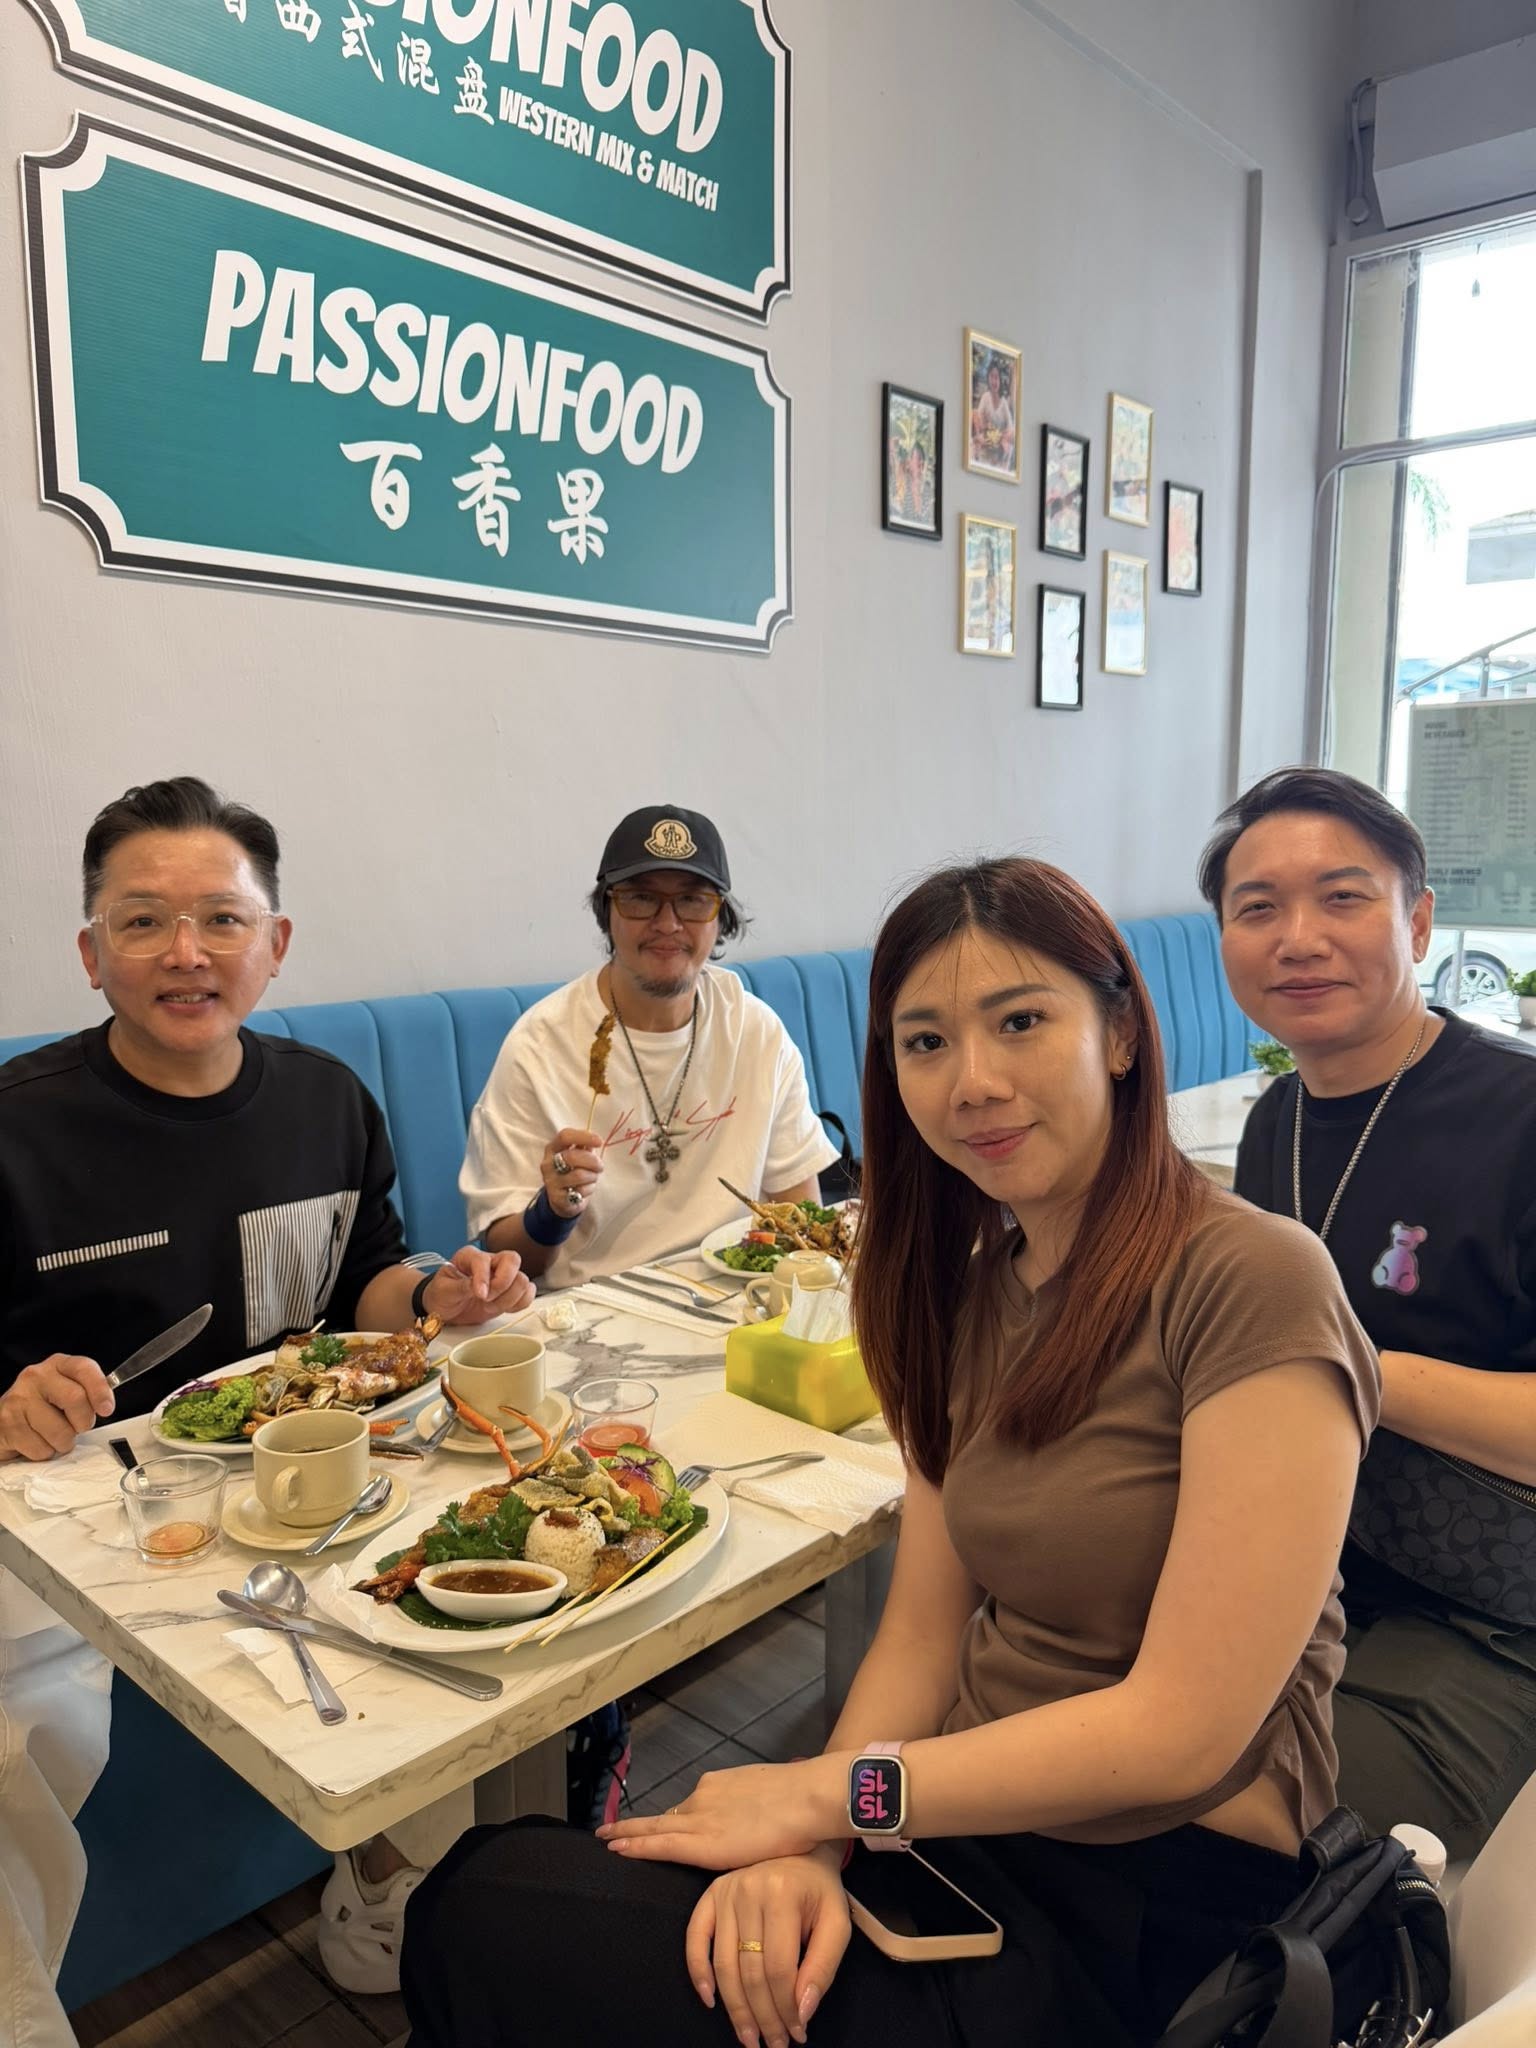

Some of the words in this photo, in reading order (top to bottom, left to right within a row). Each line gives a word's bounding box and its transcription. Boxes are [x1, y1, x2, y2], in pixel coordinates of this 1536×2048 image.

[224, 0, 495, 125] 西式混盘
[499, 86, 594, 157] WESTERN
[595, 132, 635, 176] MIX
[637, 150, 655, 184] &
[656, 159, 719, 212] MATCH
[202, 249, 704, 474] PASSIONFOOD
[339, 438, 609, 565] 百香果
[858, 1794, 888, 1819] 15
[859, 1768, 888, 1793] 15
